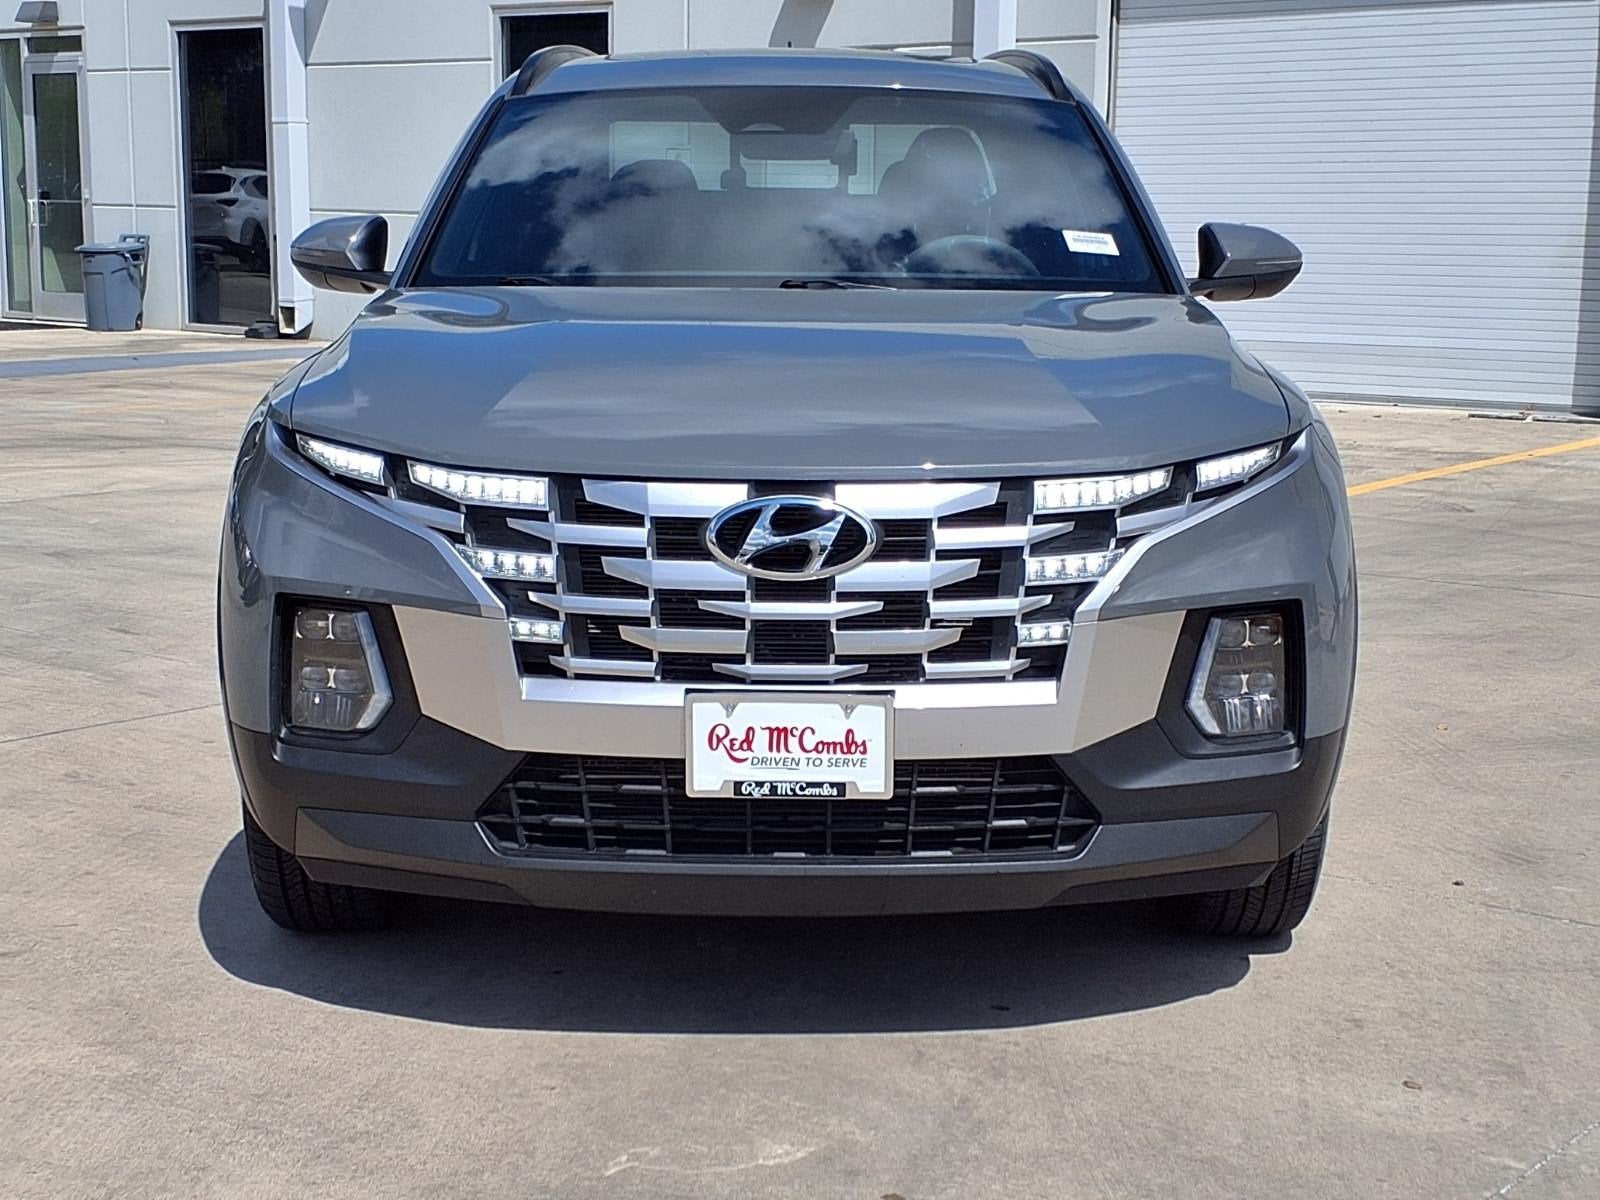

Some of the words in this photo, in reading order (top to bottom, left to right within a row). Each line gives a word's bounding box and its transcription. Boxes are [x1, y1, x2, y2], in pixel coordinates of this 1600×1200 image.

[708, 723, 755, 763] Red
[760, 726, 868, 755] McCombs
[751, 756, 800, 767] DRIVEN
[805, 757, 823, 767] TO
[827, 757, 867, 768] SERVE
[741, 781, 770, 797] Red
[774, 782, 838, 796] McCombs
